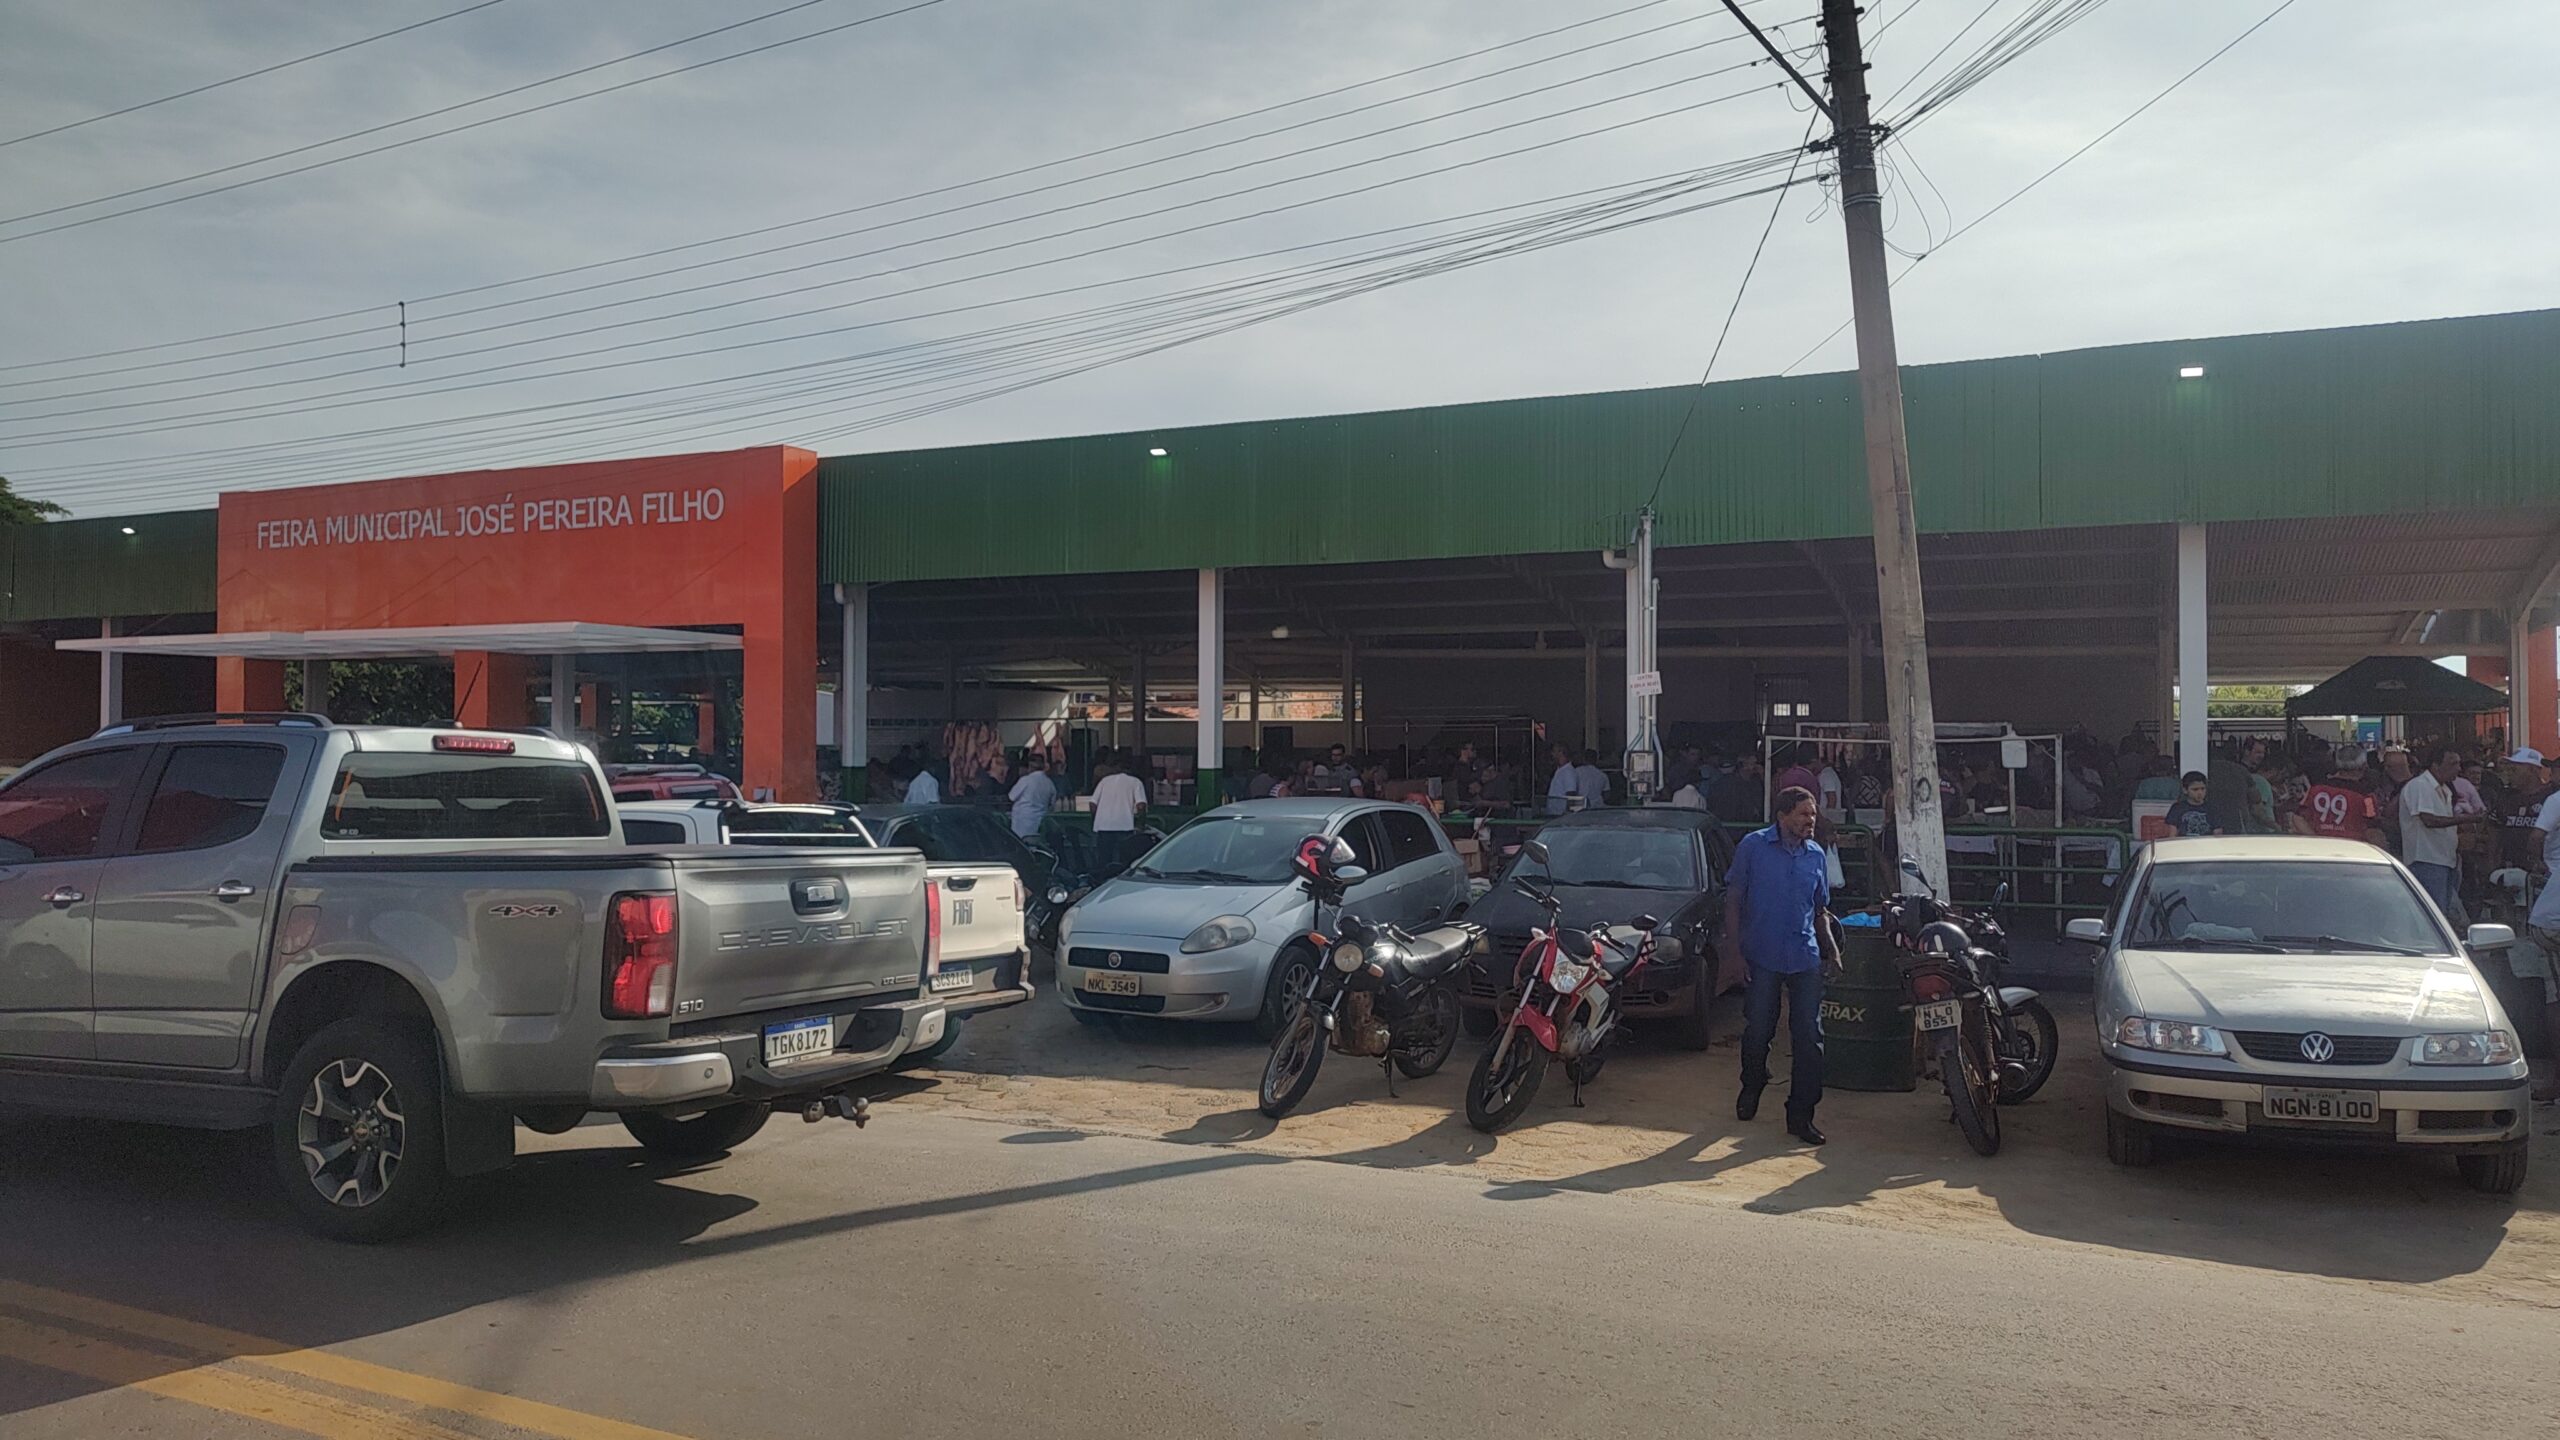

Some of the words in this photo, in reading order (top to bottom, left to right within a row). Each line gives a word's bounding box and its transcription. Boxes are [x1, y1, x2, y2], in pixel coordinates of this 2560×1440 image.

[257, 518, 319, 550] FEIRA
[325, 507, 450, 545] MUNICIPAL
[455, 494, 516, 537] JOSÉ
[523, 495, 634, 532] PEREIRA
[641, 487, 725, 524] FILHO
[2314, 792, 2347, 825] 99
[952, 898, 974, 926] FIAT
[718, 917, 908, 951] CHEVROLET
[679, 999, 704, 1013] S10
[1924, 1015, 1954, 1029] 8551
